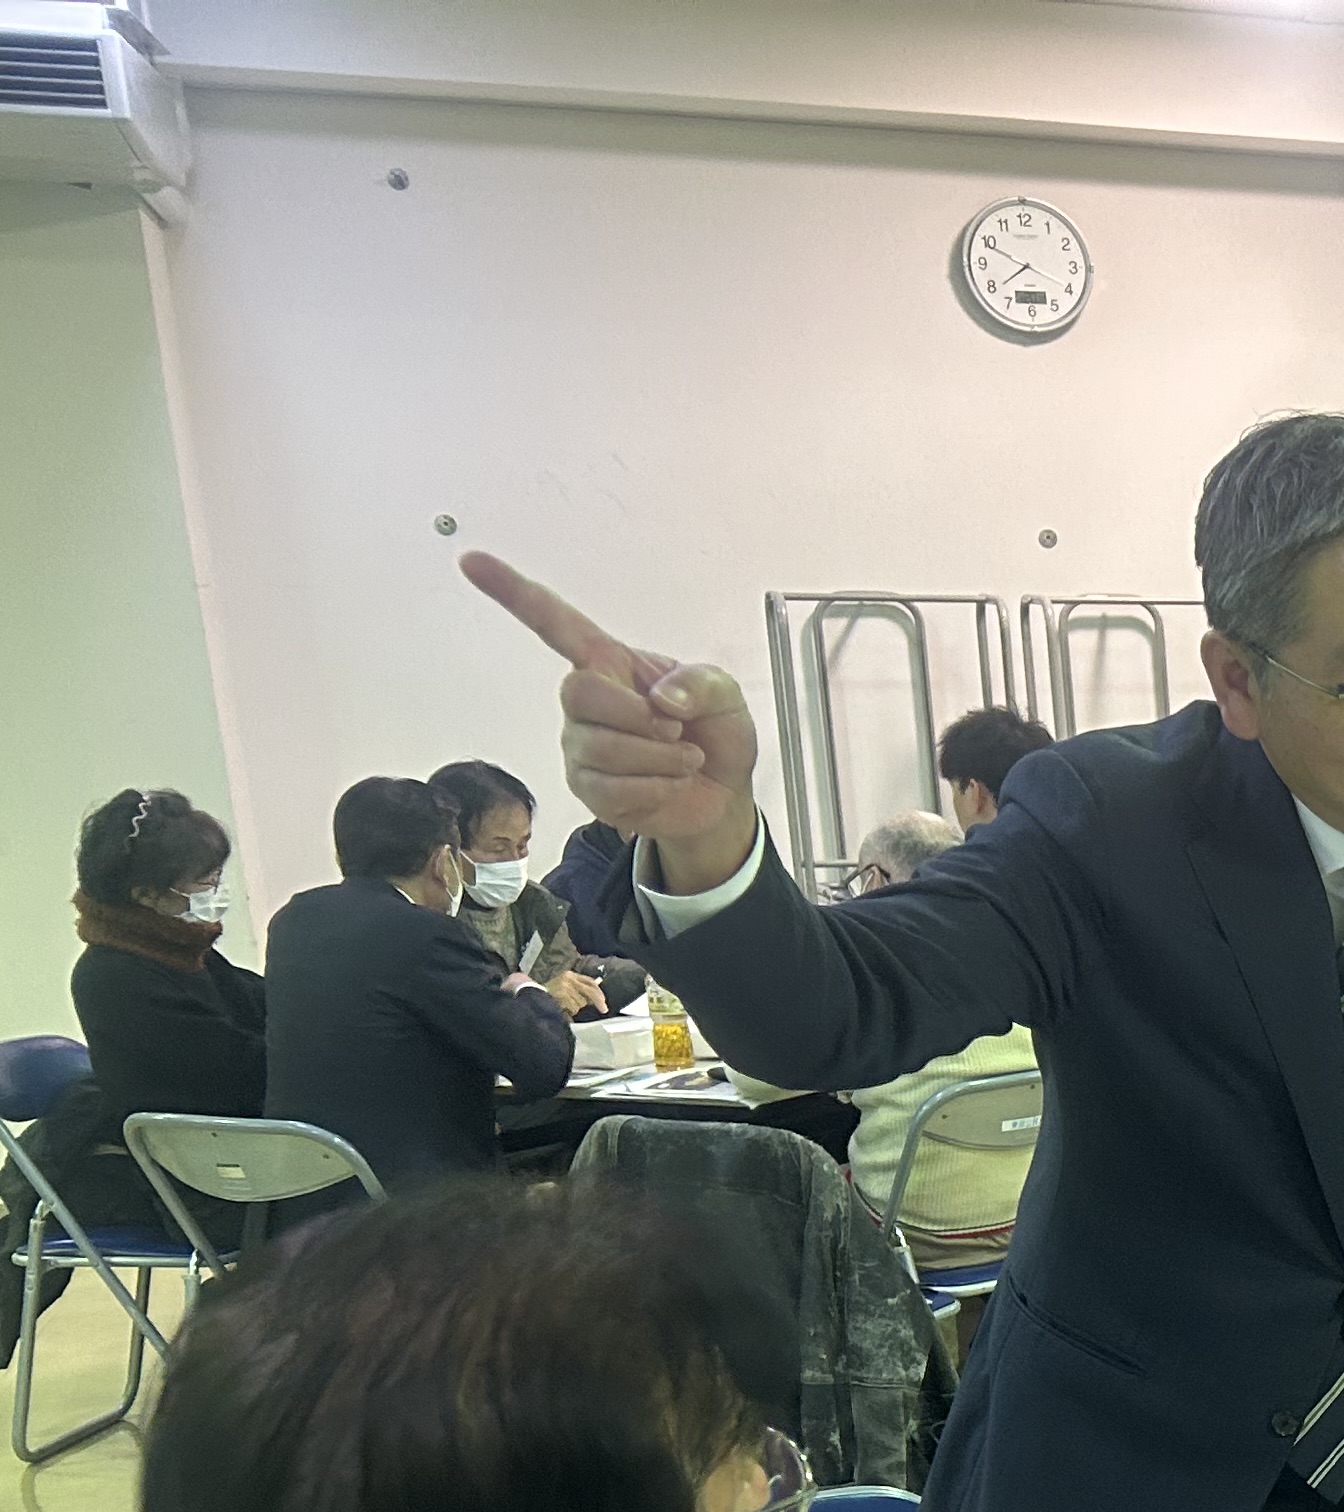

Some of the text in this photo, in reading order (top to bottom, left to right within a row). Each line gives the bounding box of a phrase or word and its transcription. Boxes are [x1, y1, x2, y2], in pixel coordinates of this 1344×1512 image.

[997, 218, 1009, 232] 11
[1017, 213, 1032, 227] 12
[1044, 221, 1051, 235] 1
[981, 235, 997, 250] 10
[1061, 237, 1071, 251] 2
[978, 257, 987, 270] 9
[1069, 261, 1078, 275] 3
[987, 280, 997, 293] 8
[1064, 283, 1073, 295] 4
[1004, 297, 1013, 310] 7
[1050, 299, 1059, 312] 5
[1028, 305, 1036, 317] 6
